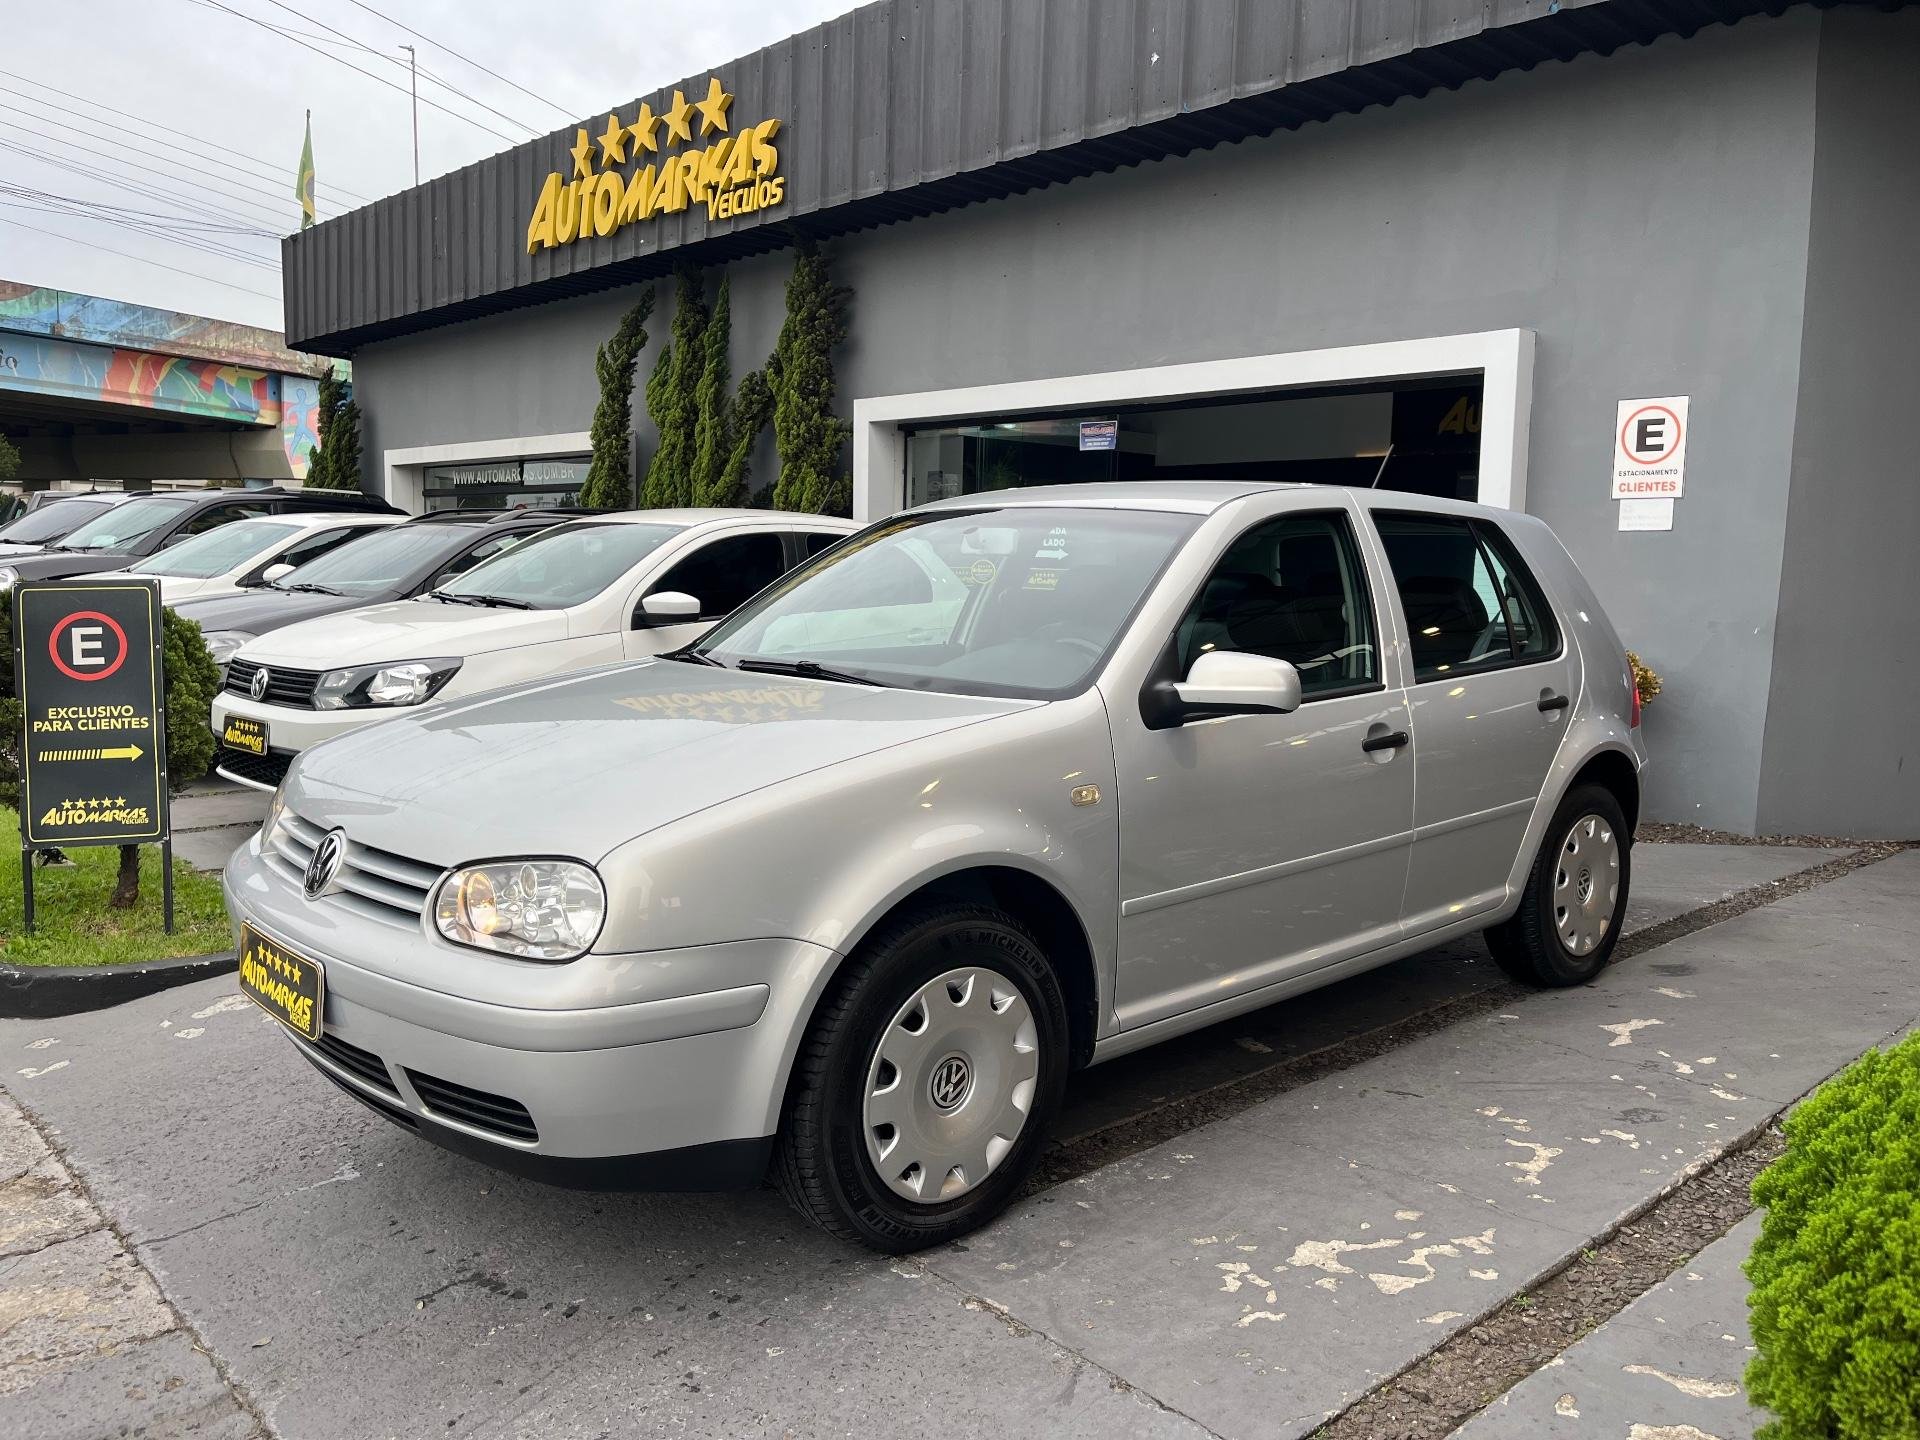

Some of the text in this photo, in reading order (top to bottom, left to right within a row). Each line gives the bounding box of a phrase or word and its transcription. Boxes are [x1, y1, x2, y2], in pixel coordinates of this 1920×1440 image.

[527, 118, 782, 255] AUTOMARKAS
[1636, 418, 1665, 452] E
[1618, 469, 1678, 477] ESTACIONAMENTO
[1618, 481, 1676, 493] CLIENTES
[1043, 538, 1066, 547] LADO
[71, 626, 105, 666] E
[48, 705, 134, 720] EXCLUSIVO
[33, 717, 149, 733] PARA CLIENTES
[40, 807, 148, 826] AUTOMARKAS
[978, 931, 1044, 975] MICHELIN
[242, 950, 313, 1020] AUTOMARKAS
